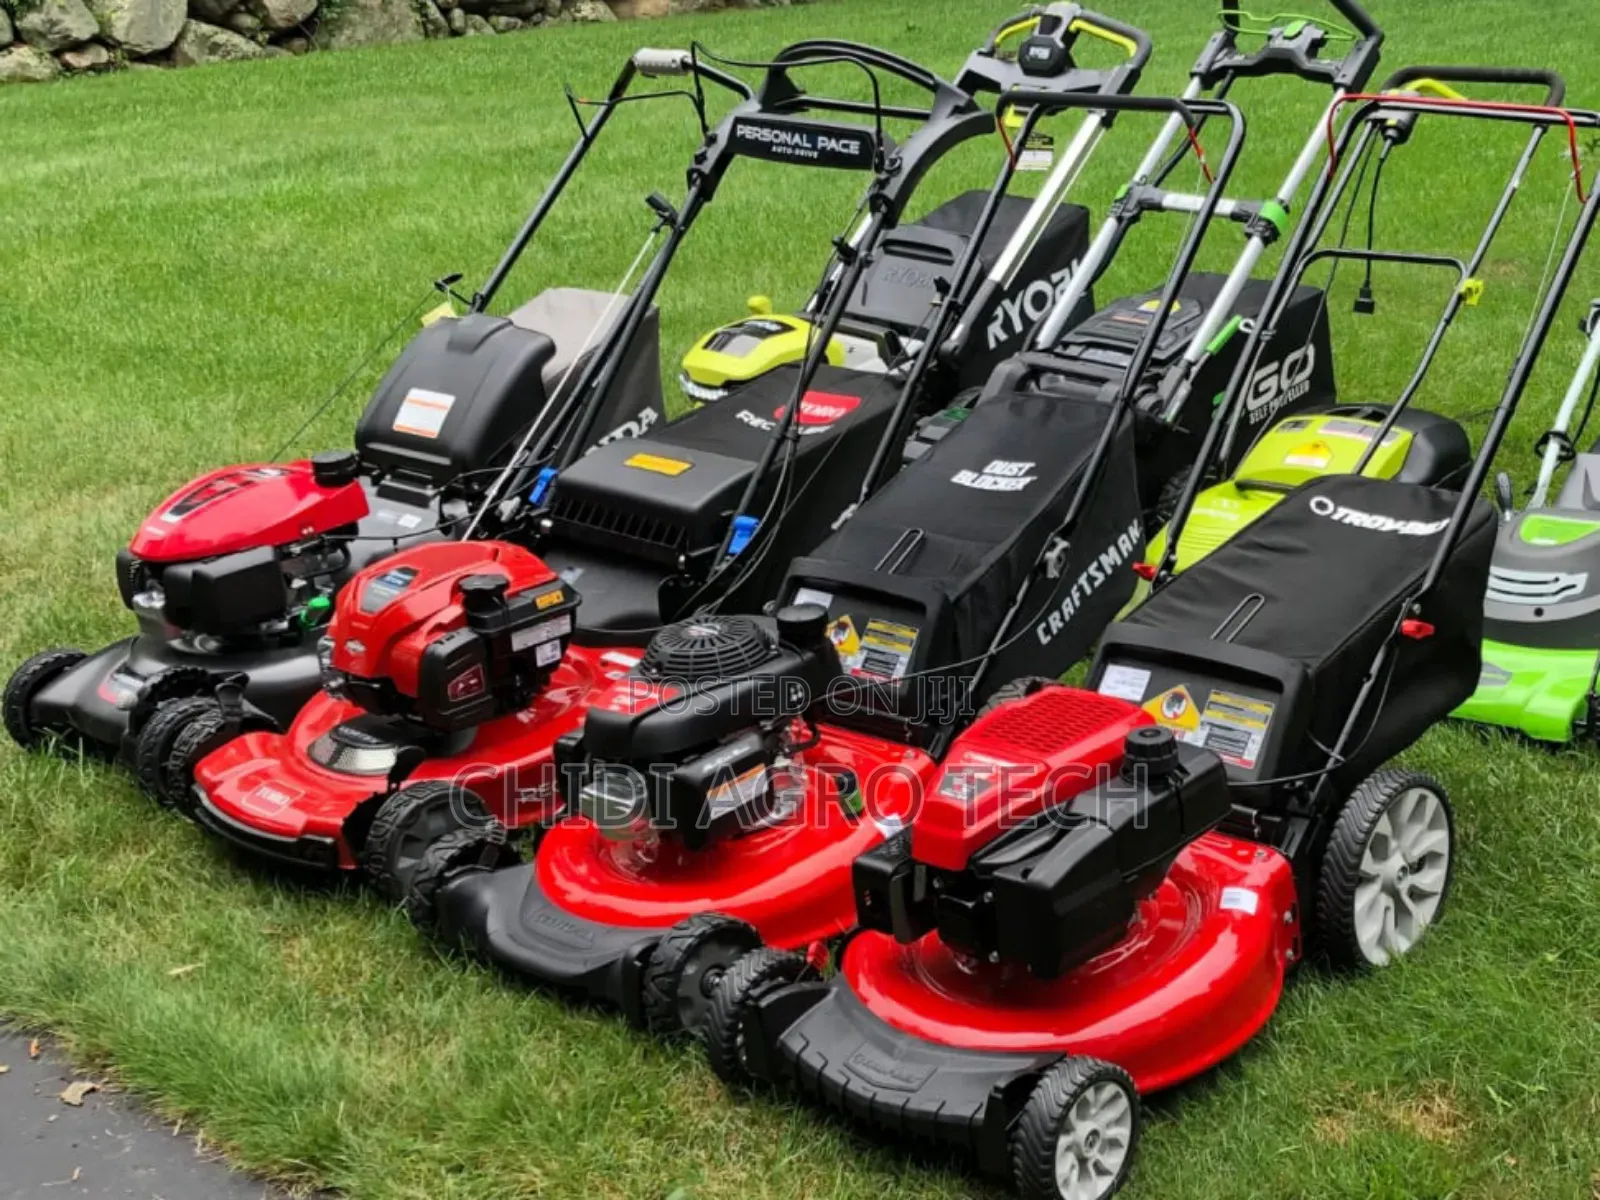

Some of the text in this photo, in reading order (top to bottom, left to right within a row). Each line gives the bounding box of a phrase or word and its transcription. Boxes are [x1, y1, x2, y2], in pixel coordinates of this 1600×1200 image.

[736, 124, 861, 155] PERSONAL PACE
[987, 257, 1087, 350] RYOB
[982, 459, 1036, 477] DUST
[1036, 517, 1144, 646] CRAFTSMAN
